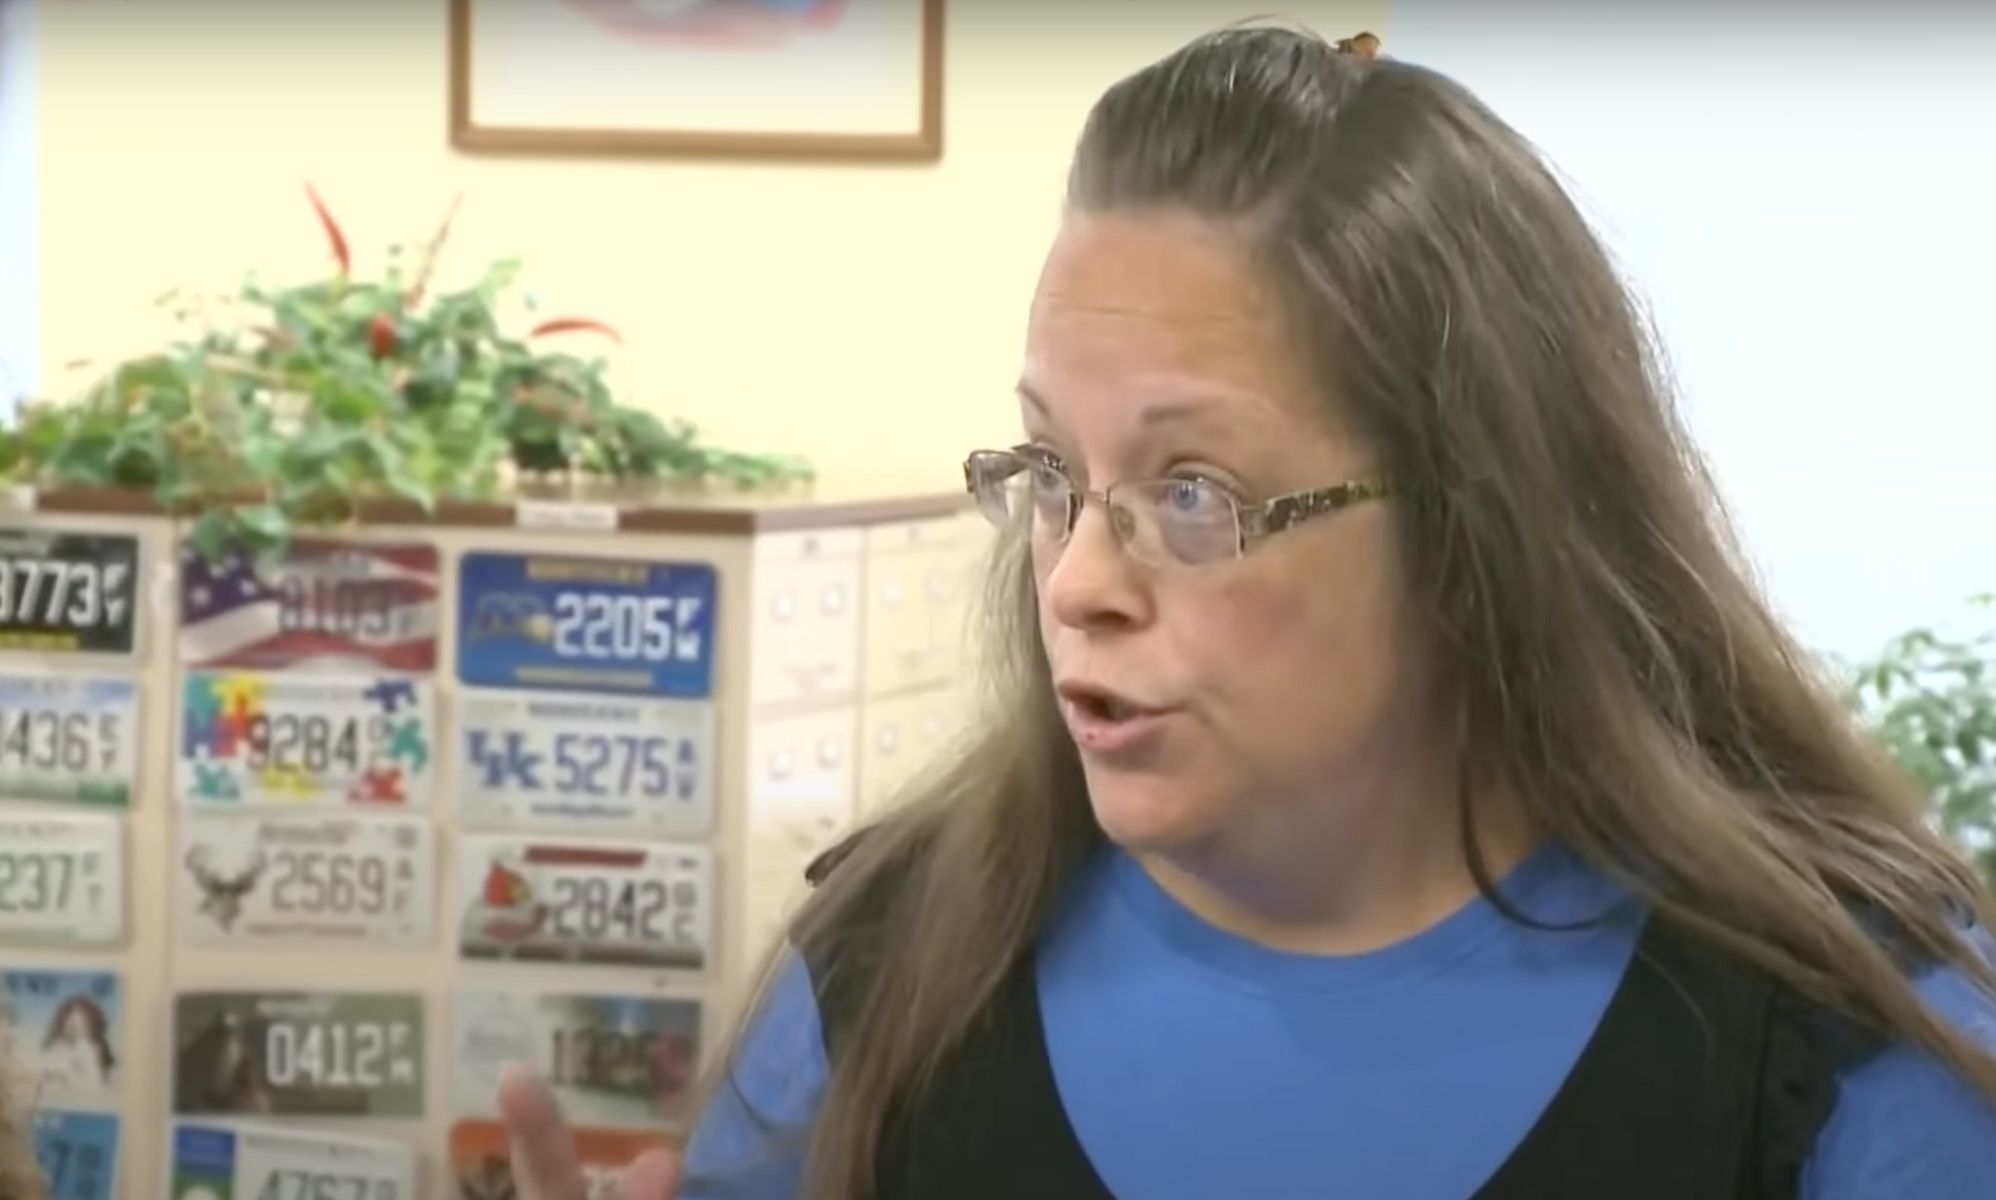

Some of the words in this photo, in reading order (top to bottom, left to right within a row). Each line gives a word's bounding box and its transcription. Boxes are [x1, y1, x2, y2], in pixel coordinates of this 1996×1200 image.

[553, 592, 672, 661] 2205
[0, 709, 89, 771] 436
[246, 712, 359, 774] 9284
[553, 732, 669, 799] 5275
[271, 849, 387, 914] 2569
[553, 876, 667, 940] 2842
[266, 1021, 384, 1087] 0412
